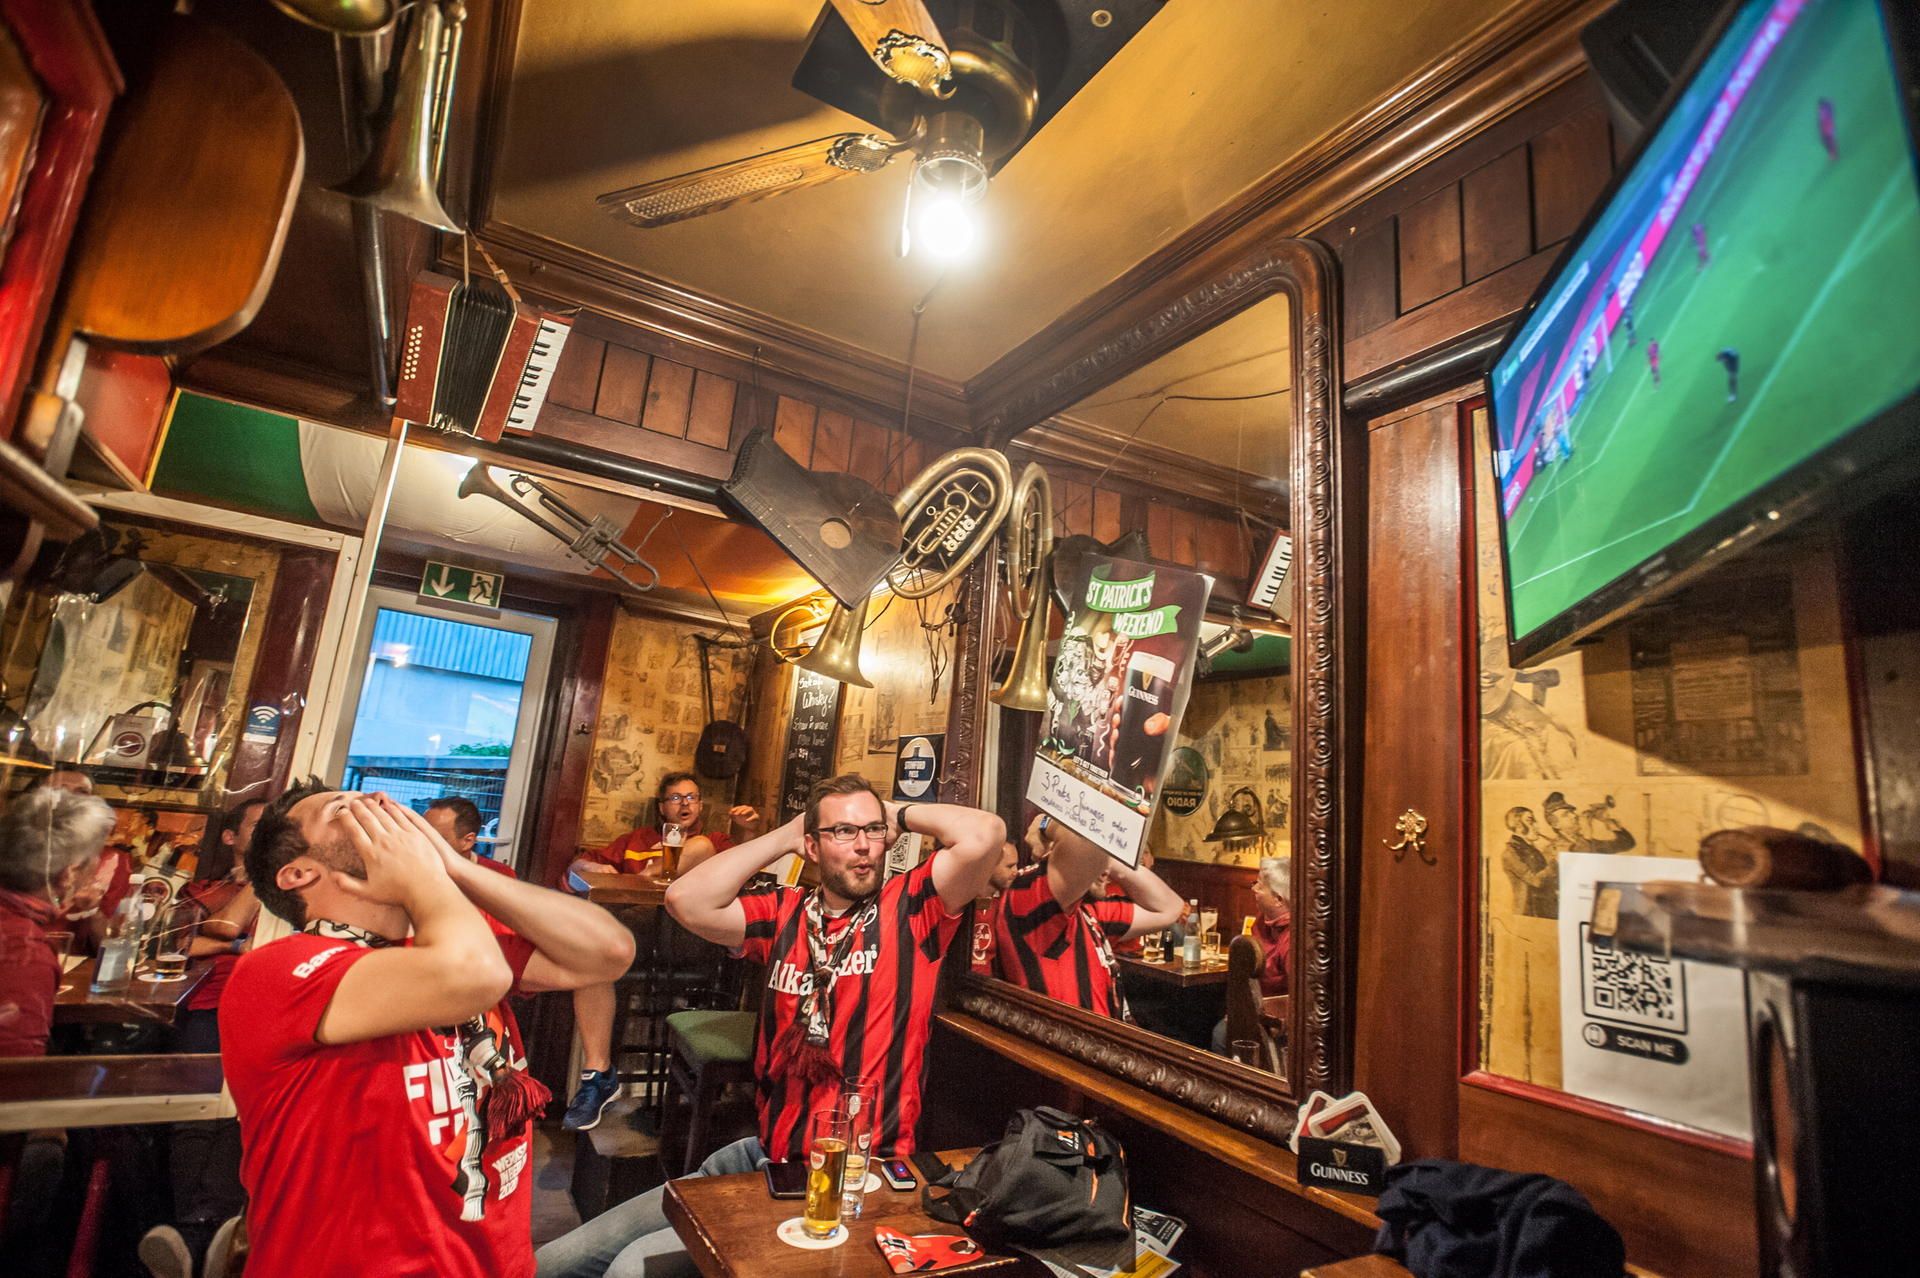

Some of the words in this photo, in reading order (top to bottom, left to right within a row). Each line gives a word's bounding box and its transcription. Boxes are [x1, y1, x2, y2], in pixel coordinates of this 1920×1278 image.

[1086, 581, 1101, 606] ST
[1100, 580, 1154, 609] PATRICK'S
[1114, 610, 1164, 636] WEEKEND
[1128, 685, 1160, 706] GUINNESS
[1041, 771, 1050, 790] 3
[1616, 1035, 1651, 1052] SCAN
[1653, 1042, 1676, 1057] ME
[1310, 1162, 1370, 1186] GUINNESS
